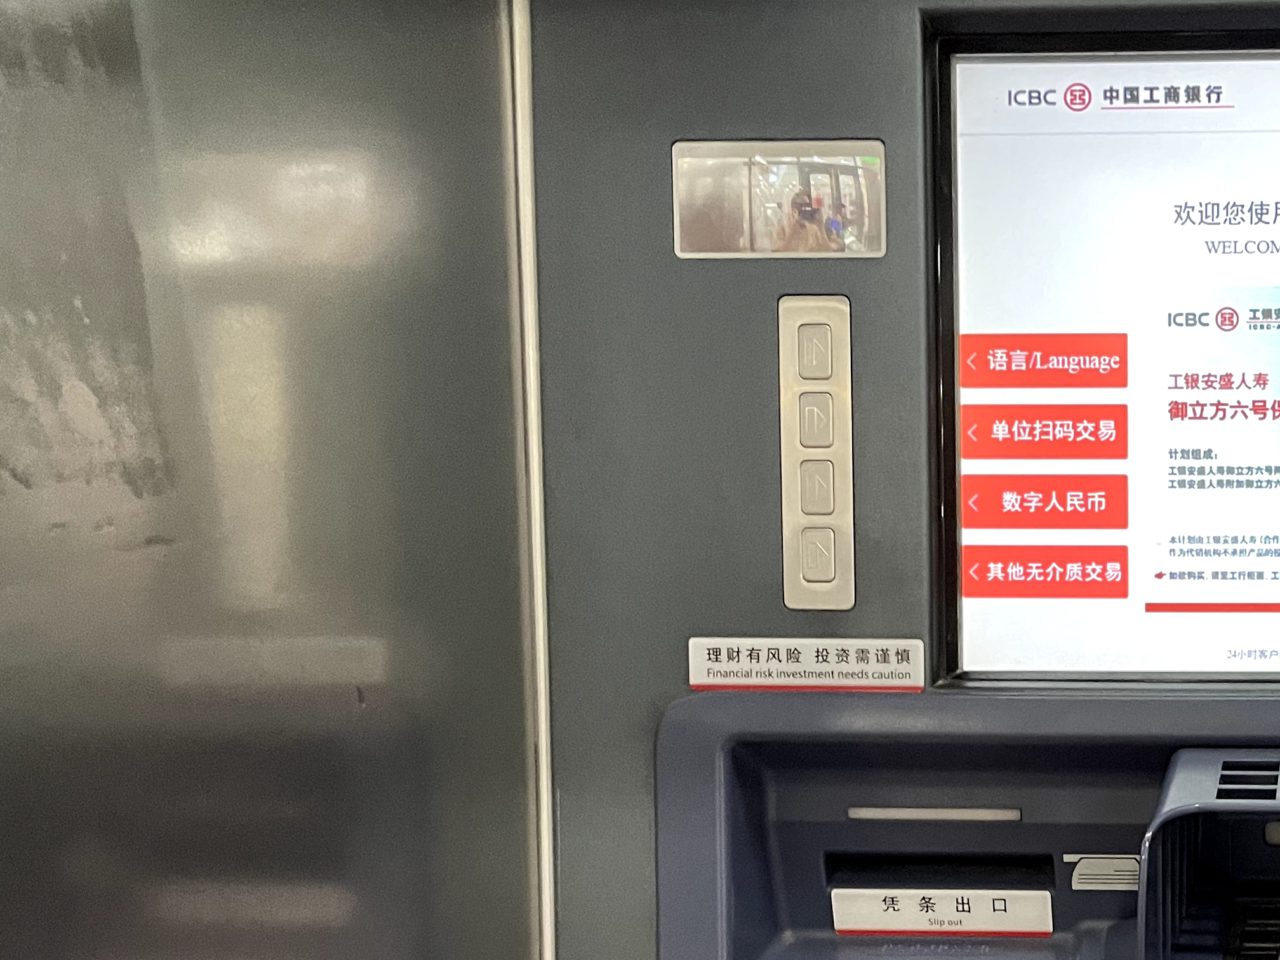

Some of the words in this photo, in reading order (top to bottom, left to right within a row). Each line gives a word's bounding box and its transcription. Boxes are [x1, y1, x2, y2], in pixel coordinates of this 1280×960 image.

[1008, 89, 1057, 106] ICBC
[1103, 85, 1224, 105] 中国工商银行
[1167, 312, 1210, 327] ICBC
[987, 349, 1121, 372] 语言/Language
[1168, 373, 1270, 391] 工银安盛人寿
[991, 420, 1117, 443] 单位扫码交易
[1001, 491, 1107, 513] 数字人民币
[986, 562, 1123, 583] 其他无介质交易
[706, 647, 803, 665] 理财有风险
[814, 647, 912, 665] 投资需谨慎
[707, 668, 752, 681] Financial
[755, 668, 775, 681] risk
[776, 668, 835, 681] investment
[837, 668, 869, 681] needs
[872, 668, 912, 681] caution
[882, 895, 1008, 914] 凭条出口
[928, 917, 946, 928] Slip
[947, 918, 963, 927] out
